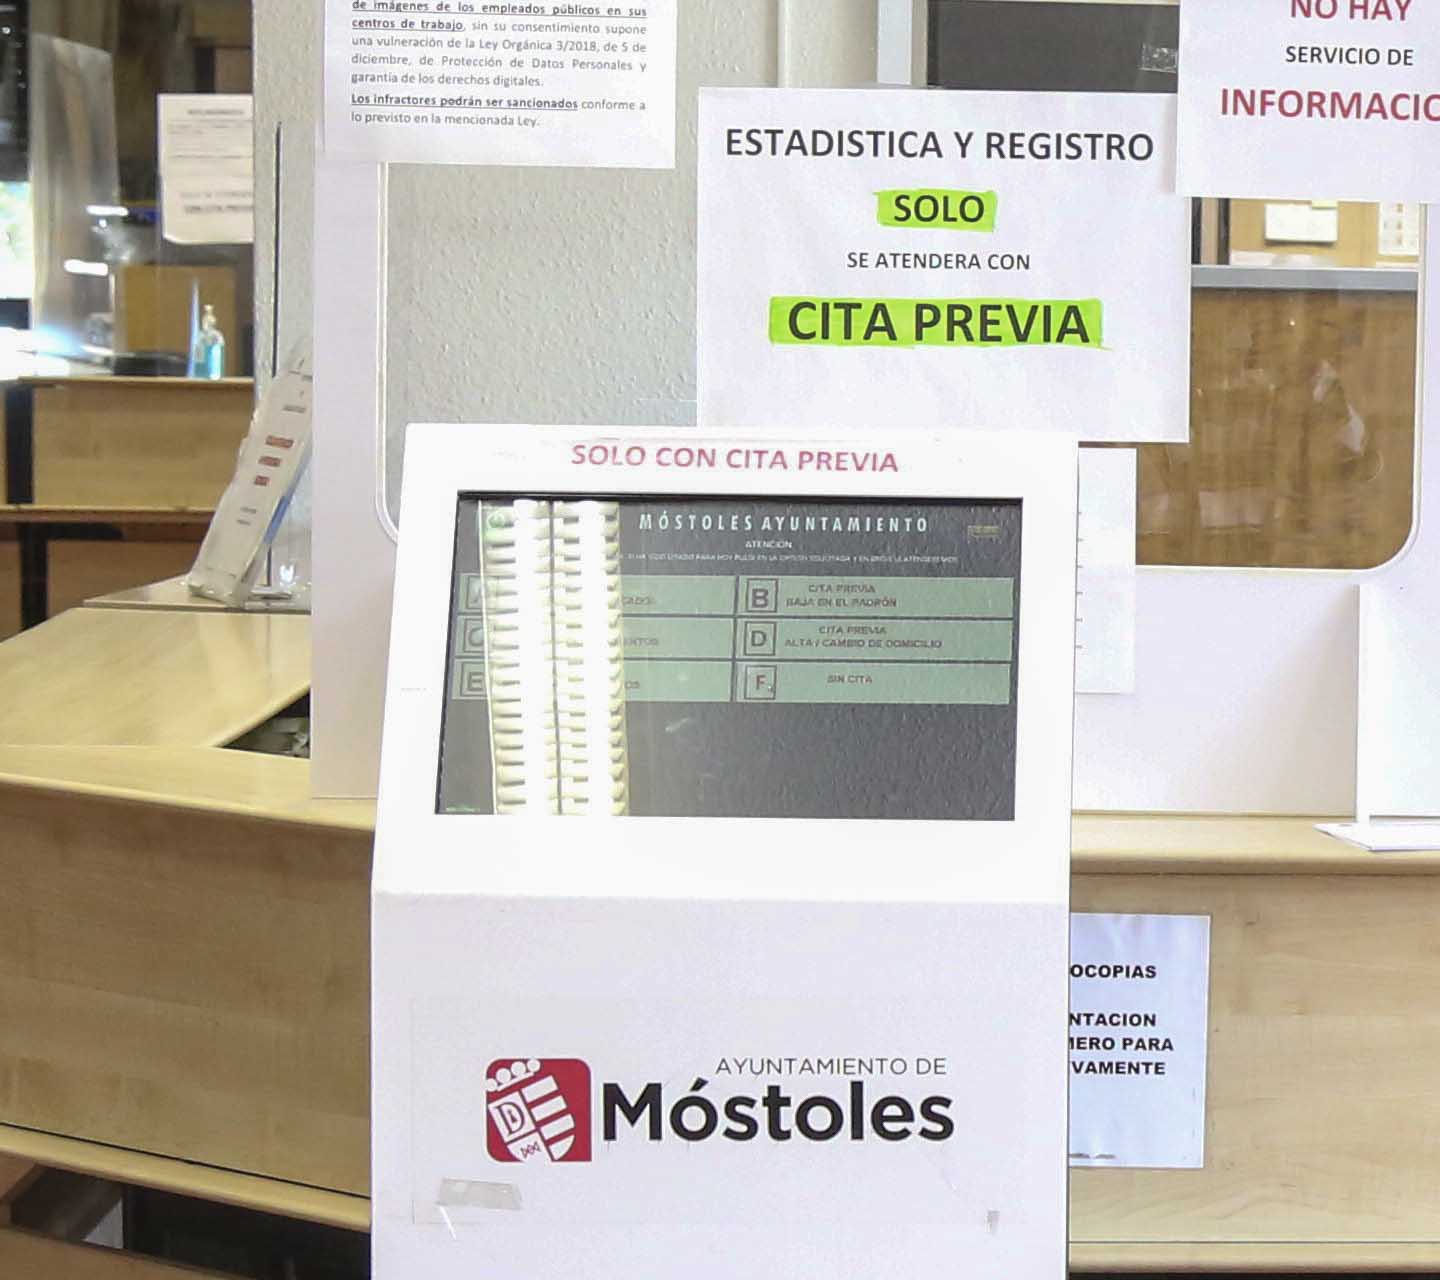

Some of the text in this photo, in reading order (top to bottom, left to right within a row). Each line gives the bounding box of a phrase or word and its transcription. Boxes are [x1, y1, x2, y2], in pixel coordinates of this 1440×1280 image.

[372, 0, 429, 15] imágenes
[434, 0, 451, 12] de
[456, 0, 475, 13] los
[480, 1, 546, 17] empleados
[551, 2, 601, 18] públicos
[605, 6, 622, 16] en
[627, 6, 647, 16] sus
[350, 16, 647, 37] centros de trabajo, sin su consentimiento supone
[350, 35, 647, 55] una vulneración de la Ley Orgánica 3/2018, de 5 de
[1285, 44, 1413, 66] SERVICIO DE
[351, 53, 647, 74] diciembre, de Protección de Datos Personales y
[399, 72, 416, 84] de
[417, 72, 435, 85] los
[436, 73, 491, 86] derechos
[491, 74, 544, 90] digitales.
[350, 92, 646, 110] Los infractores podrán ser sancionados conforme a
[351, 110, 540, 129] lo previsto en la mencionada Ley.
[726, 127, 1153, 161] ESTADISTICA Y REGISTRO
[893, 193, 984, 223] SOLO
[846, 251, 1030, 270] SE ATENDERA CON
[787, 300, 1090, 343] CITA PREVIA
[571, 443, 898, 473] SOLO CON CITA PREVIA
[639, 511, 929, 533] MÓSTOLES AYUNTAMIENTO
[751, 588, 769, 608] B
[751, 630, 767, 647] D
[755, 674, 765, 690] F
[1122, 1037, 1174, 1052] PARA
[714, 1056, 946, 1076] AYUNTAMIENTO DE
[603, 1079, 956, 1144] Móstoles
